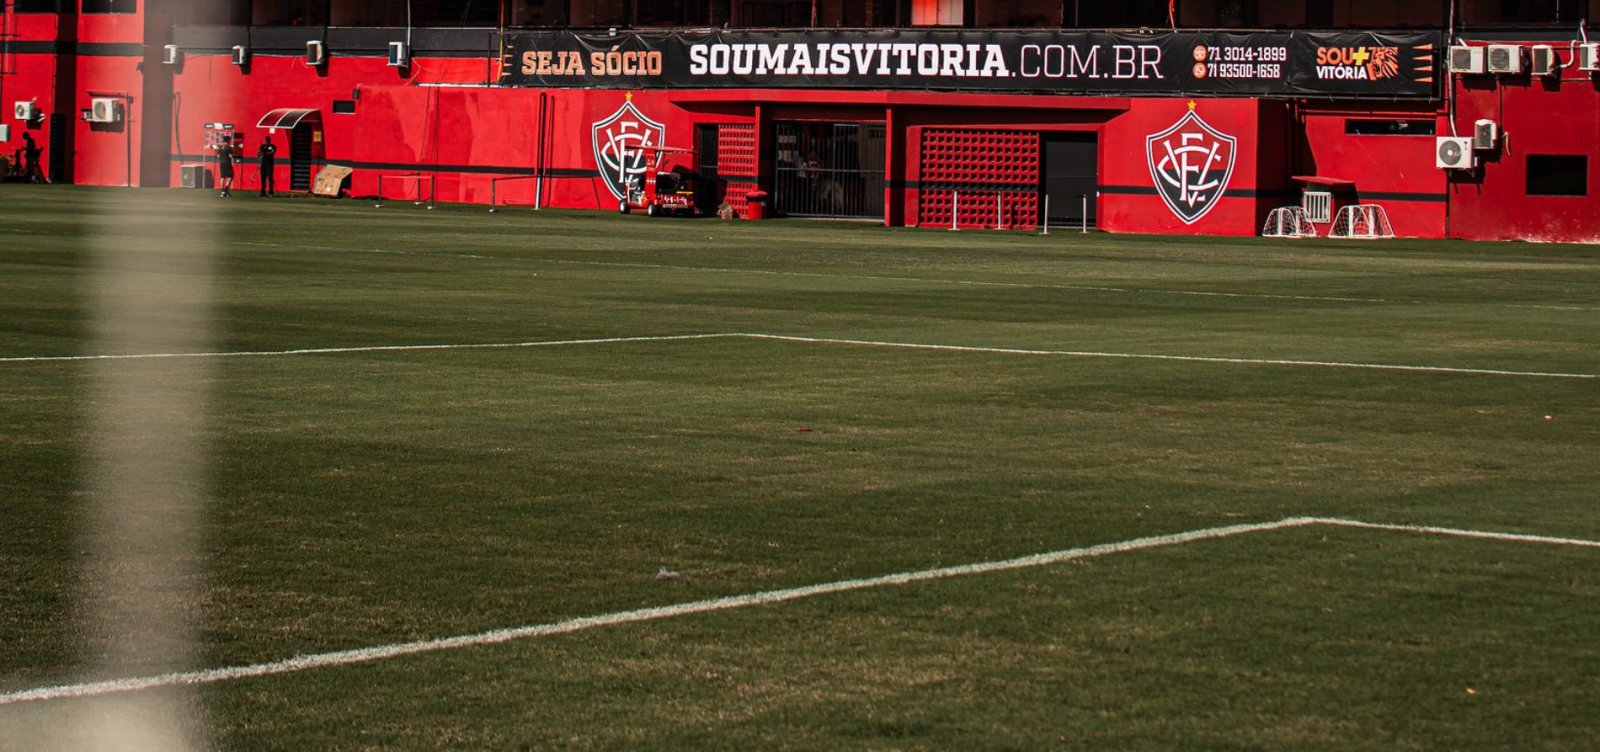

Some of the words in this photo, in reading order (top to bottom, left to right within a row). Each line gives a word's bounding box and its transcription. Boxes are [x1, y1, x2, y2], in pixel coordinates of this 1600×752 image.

[521, 51, 585, 75] SEJA
[591, 46, 662, 75] SÓCIO
[690, 43, 1165, 79] SOUMAISVITORIA.COM.BR
[1208, 46, 1221, 61] 71
[1224, 46, 1287, 61] 3014-1899
[1208, 63, 1217, 78] 71
[1219, 63, 1281, 78] 93500-1658
[1316, 64, 1367, 79] VITÓRIA
